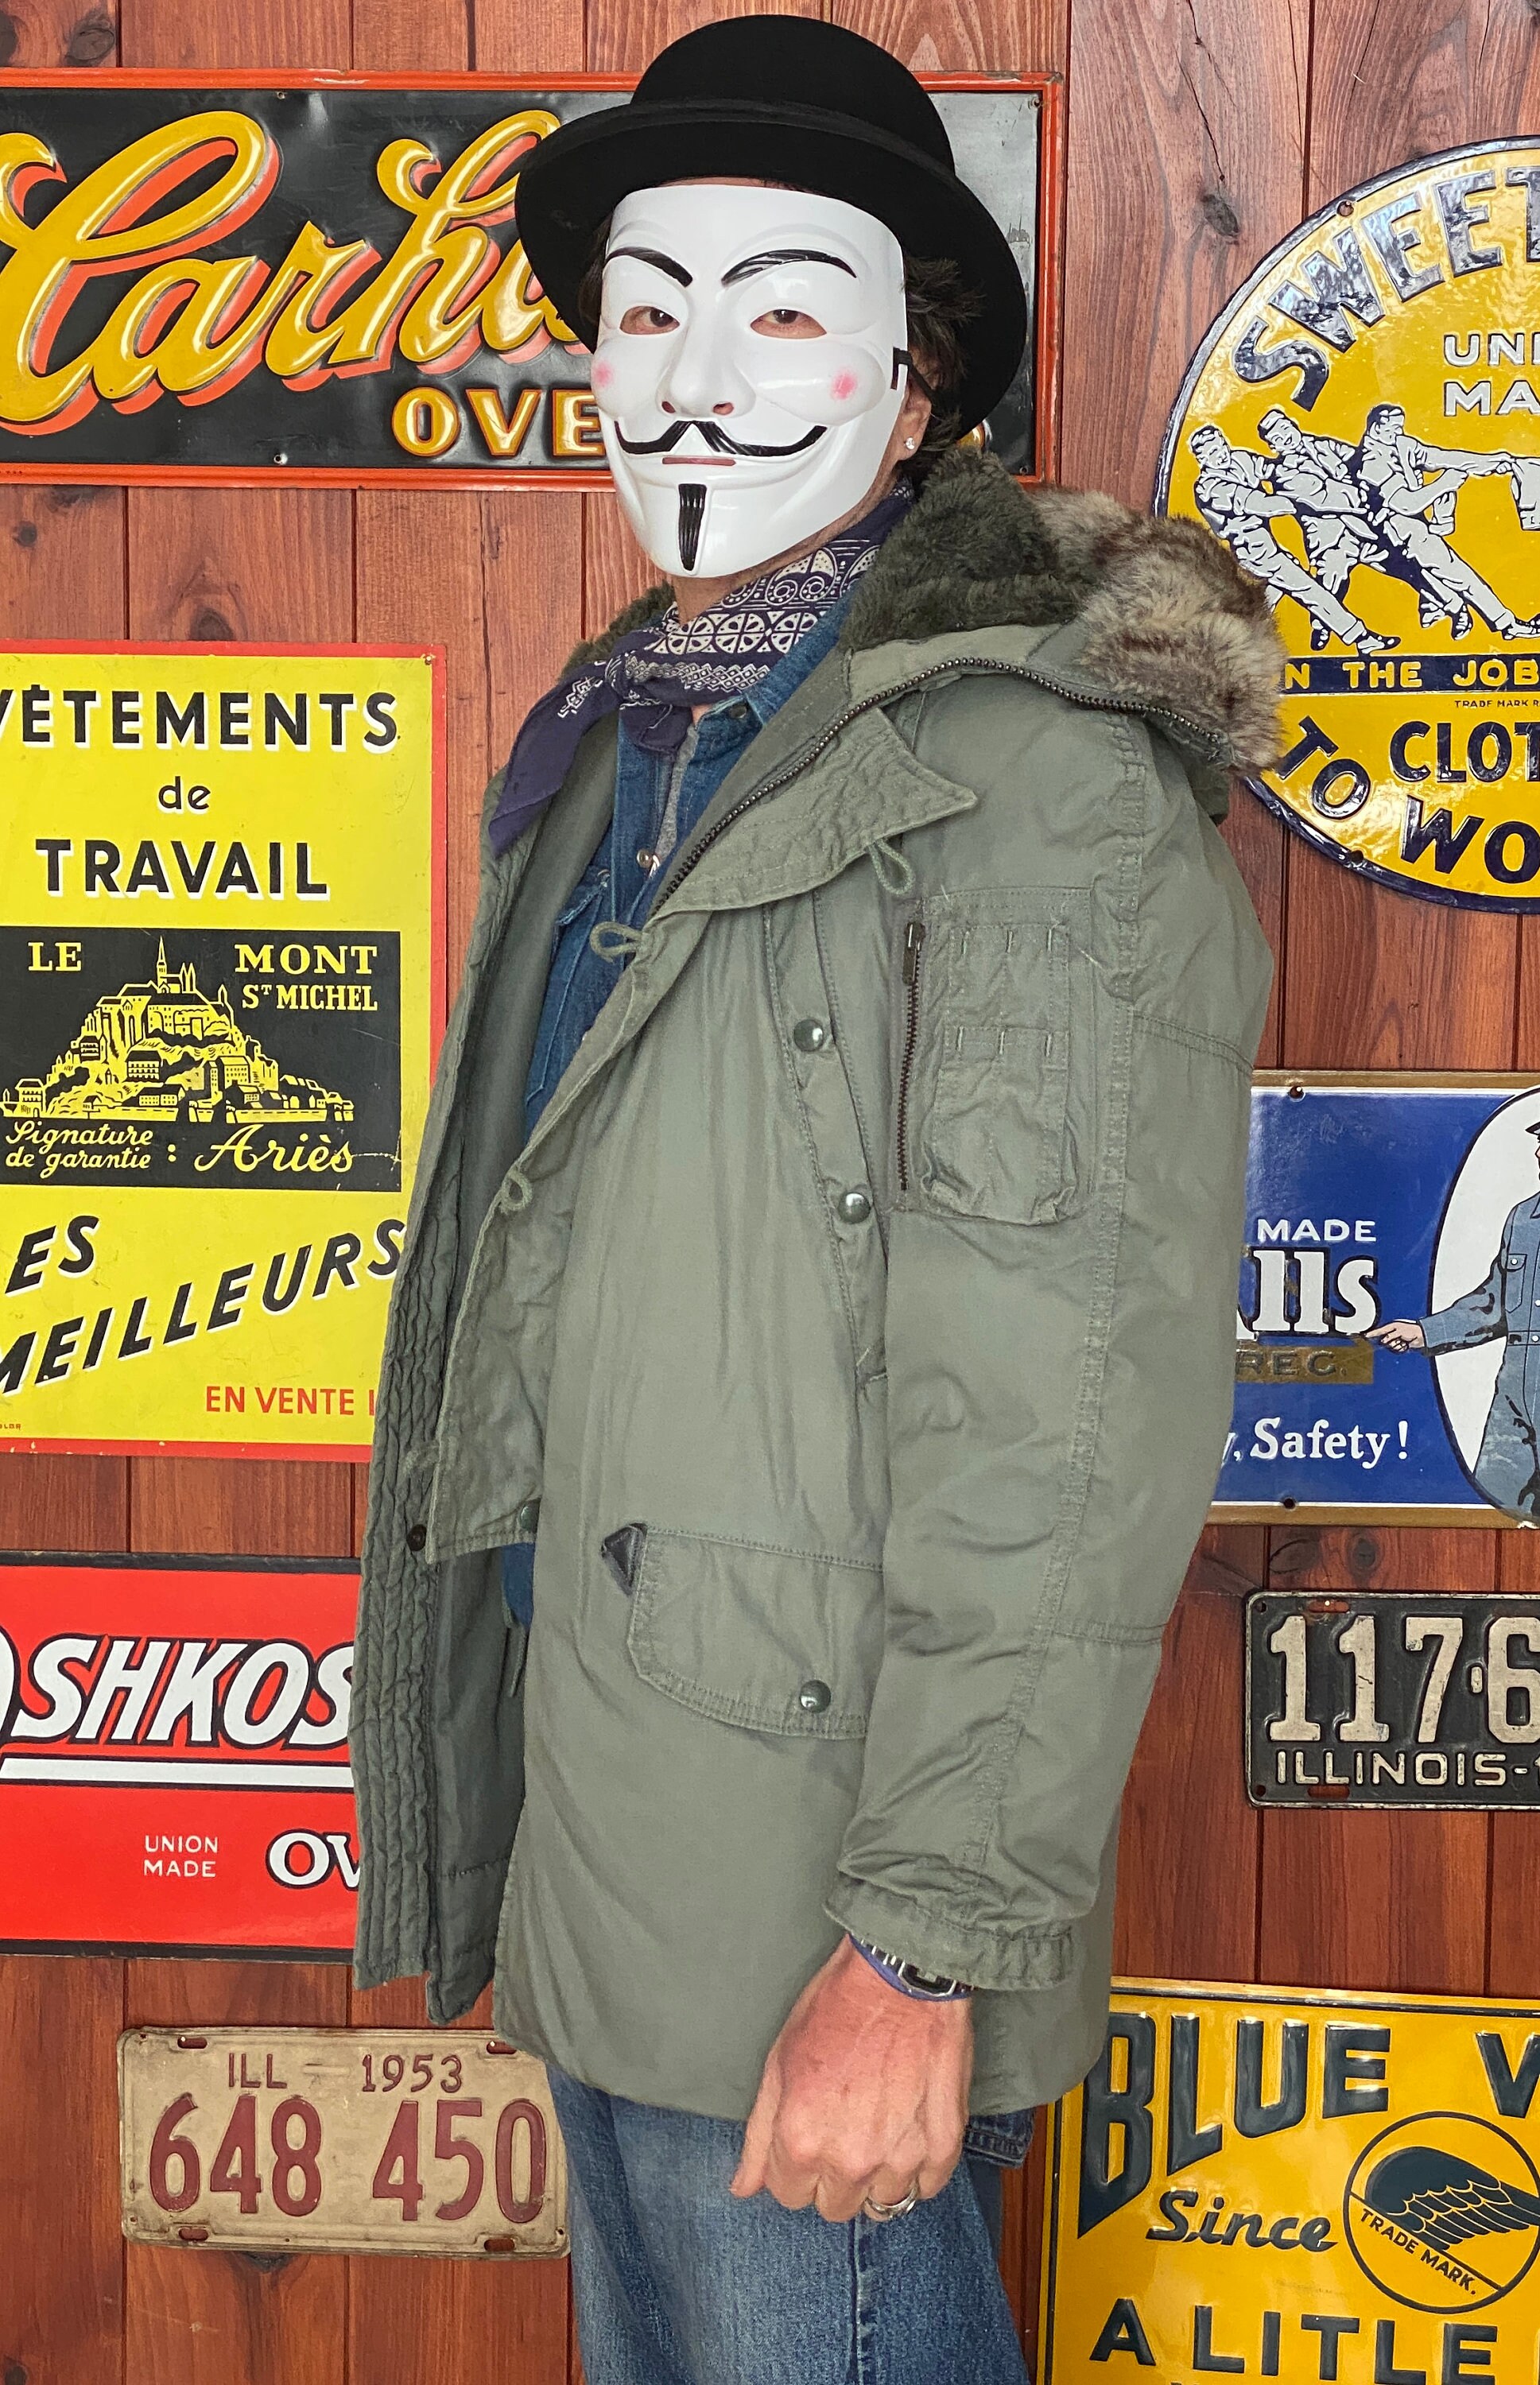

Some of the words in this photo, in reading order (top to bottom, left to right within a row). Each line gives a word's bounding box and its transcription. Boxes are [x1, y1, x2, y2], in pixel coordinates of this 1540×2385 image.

[1444, 379, 1540, 417] MA
[391, 387, 607, 457] OVE
[1342, 661, 1422, 688] THE
[1453, 658, 1539, 687] JOB
[1454, 700, 1492, 708] TRADE
[1497, 699, 1529, 708] MARK
[1274, 716, 1371, 820] TO
[157, 775, 211, 812] de
[1399, 796, 1540, 884] WO
[35, 839, 330, 899] TRAVAIL
[28, 941, 82, 972] LE
[235, 944, 378, 975] MONT
[276, 985, 378, 1012] MICHEL
[6, 1119, 154, 1154] Signature
[6, 1151, 34, 1169] de
[40, 1146, 152, 1179] garantie
[1256, 1218, 1377, 1243] MADE
[1236, 1248, 1379, 1340] lls
[206, 1386, 245, 1412] EN
[255, 1386, 355, 1415] VENTE
[1249, 1417, 1409, 1469] Safety!
[0, 1627, 355, 1748] SHKOS
[145, 1835, 219, 1853] UNION
[144, 1860, 216, 1878] MADE
[228, 2053, 287, 2089] ILL
[363, 2053, 463, 2092] 1953
[1077, 2011, 1391, 2238] BLUE
[149, 2093, 322, 2217] 648
[372, 2098, 547, 2224] 450
[1146, 2189, 1338, 2253] Since
[1360, 2208, 1418, 2255] TRADE
[1419, 2247, 1477, 2295] MARK.
[1089, 2298, 1156, 2366] A
